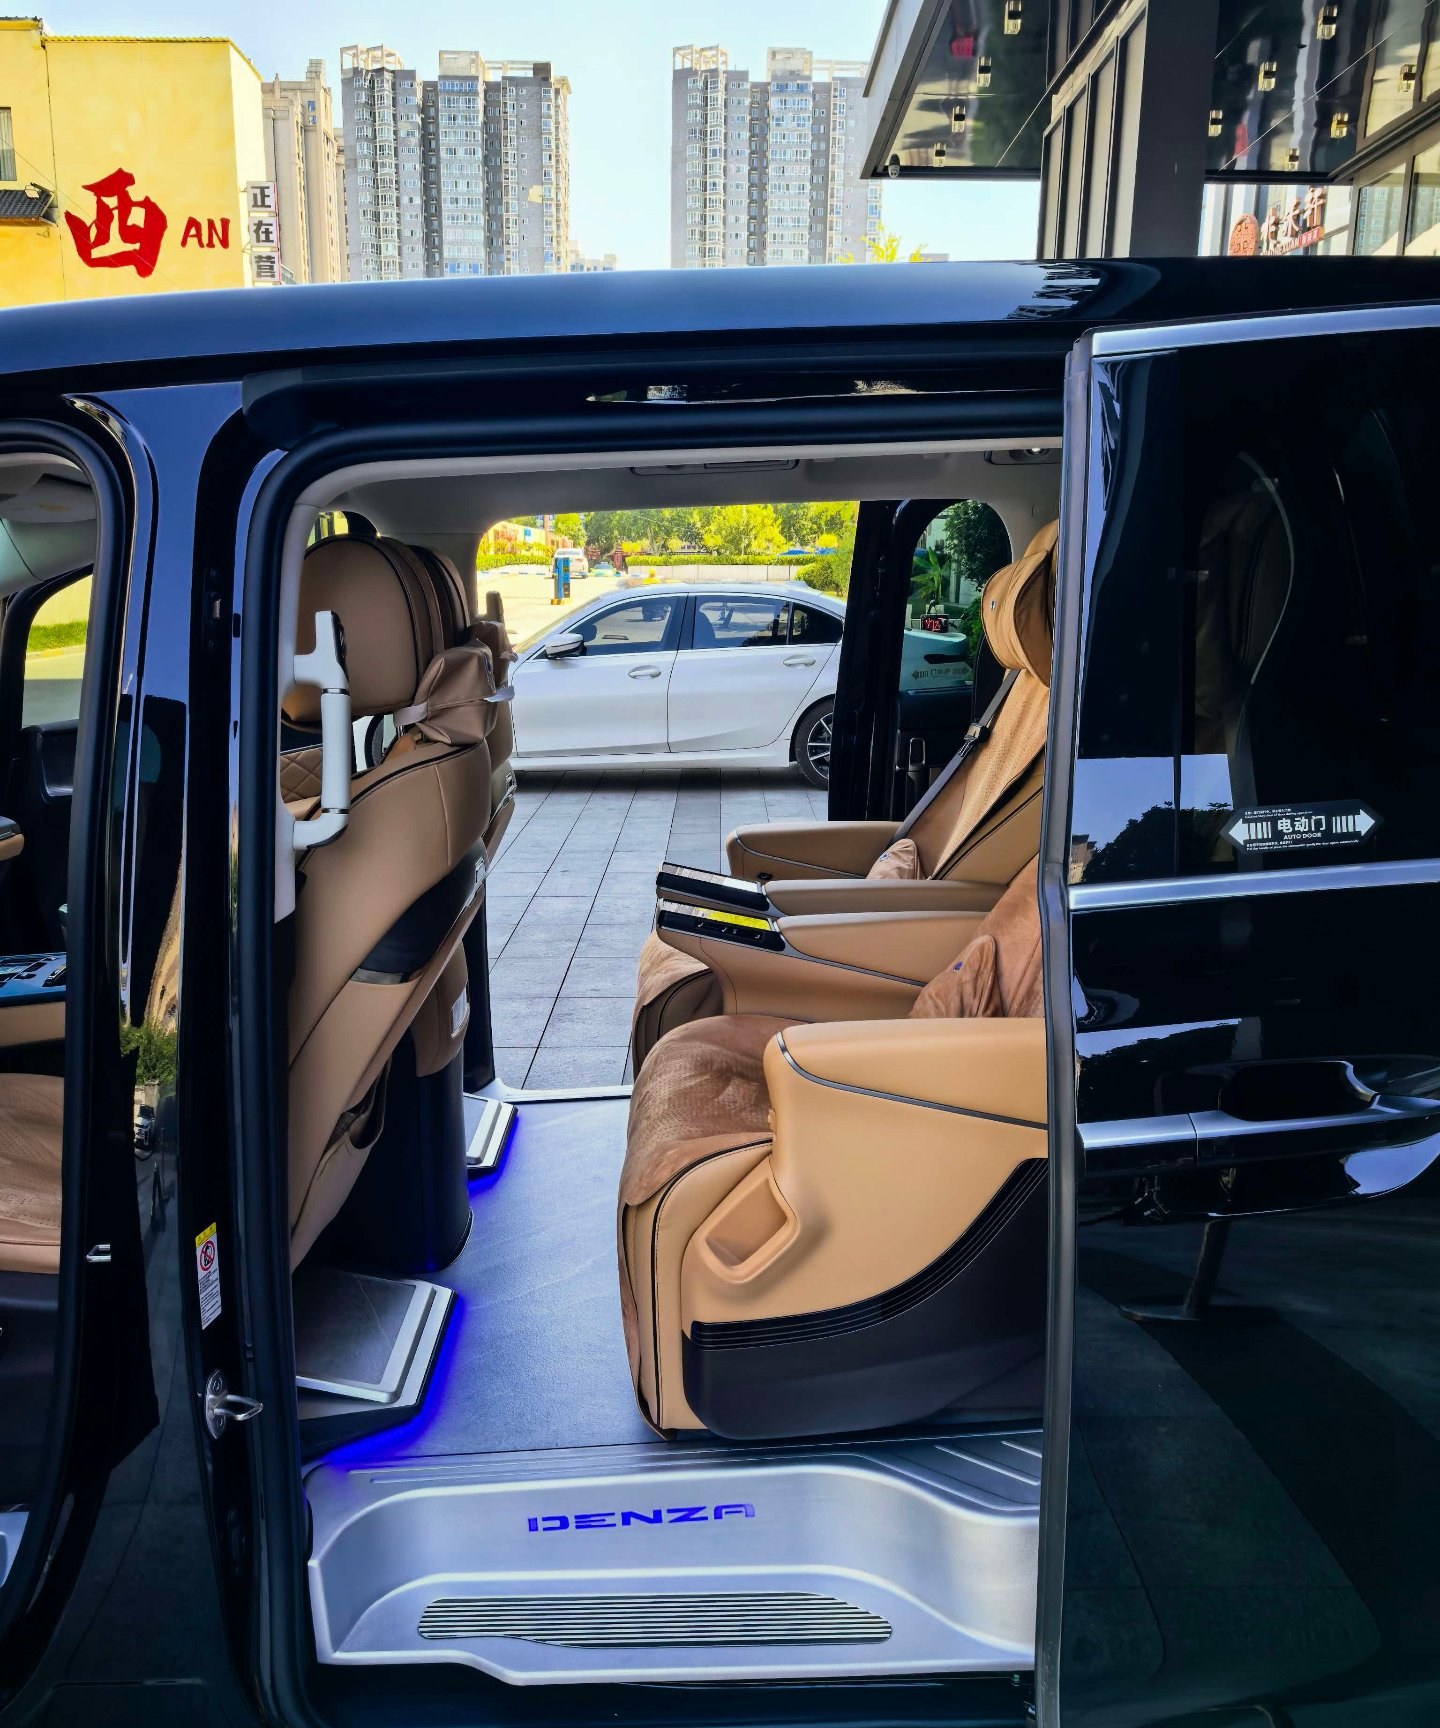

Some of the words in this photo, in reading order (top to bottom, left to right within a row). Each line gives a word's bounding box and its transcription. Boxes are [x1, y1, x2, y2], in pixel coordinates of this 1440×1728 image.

[64, 167, 168, 278] 西
[180, 216, 231, 250] AN
[250, 185, 276, 279] 正在营
[1277, 815, 1326, 833] 电动门
[527, 1503, 756, 1532] DENZA
